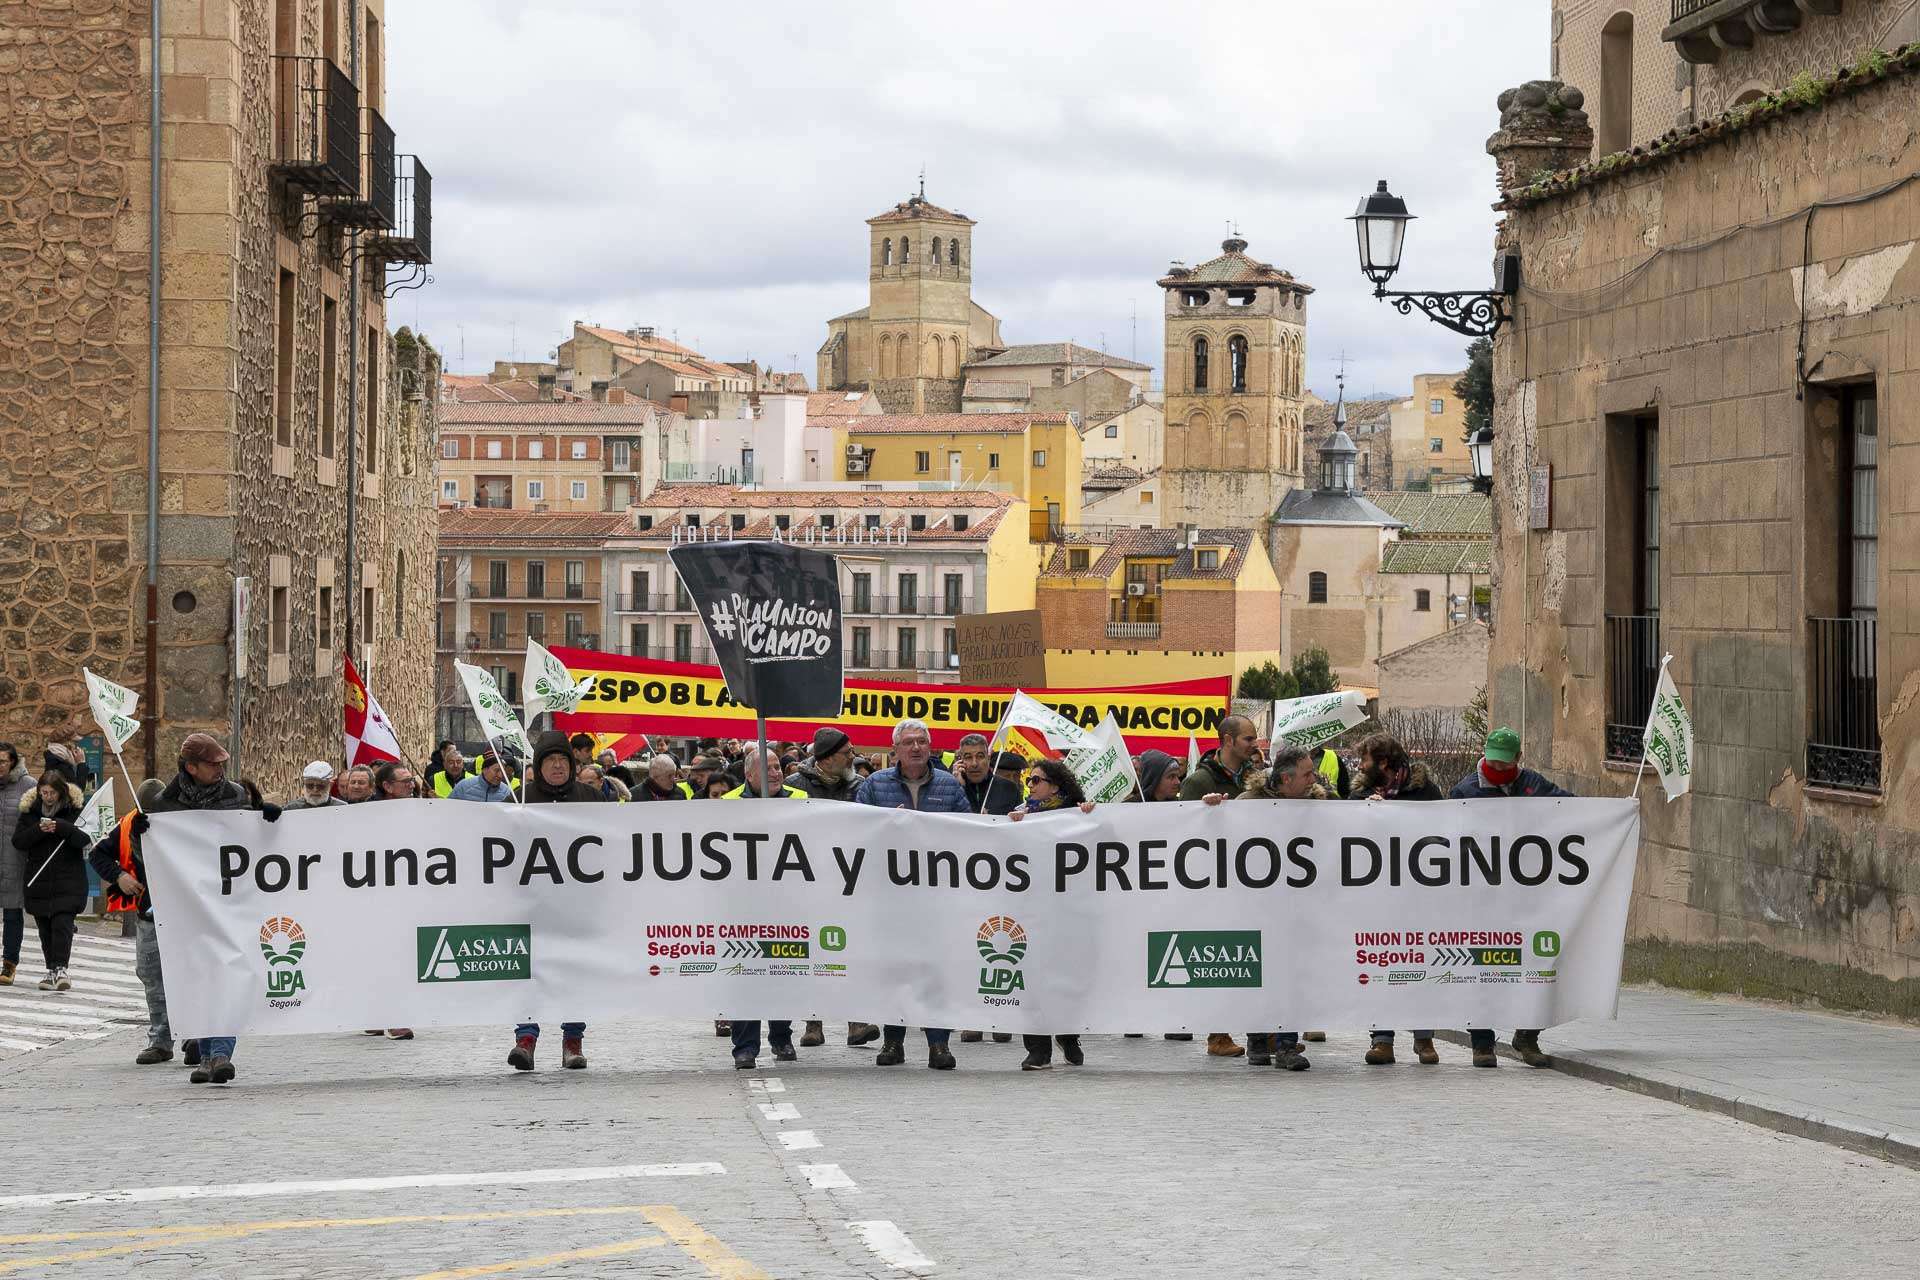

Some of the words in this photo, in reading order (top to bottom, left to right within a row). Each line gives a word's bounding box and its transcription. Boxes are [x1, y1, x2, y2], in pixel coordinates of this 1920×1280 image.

[772, 526, 908, 545] ACUEDUCTO
[841, 692, 951, 722] HUNDE
[1107, 704, 1225, 731] NACION
[1663, 703, 1682, 728] UPA
[220, 844, 321, 895] Por
[343, 847, 456, 889] una
[482, 835, 604, 885] PAC
[623, 832, 815, 882] JUSTA
[833, 847, 865, 897] y
[888, 849, 1031, 893] unos
[1055, 836, 1318, 893] PRECIOS
[1341, 834, 1590, 887] DIGNOS
[647, 925, 692, 938] UNION
[696, 924, 714, 938] DE
[719, 924, 809, 939] CAMPESINOS
[1355, 932, 1401, 946] UNION
[1406, 932, 1424, 946] DE
[1428, 931, 1523, 946] CAMPESINOS
[457, 938, 529, 957] ASAJA
[648, 940, 716, 959] Segovia
[771, 943, 806, 957] UCCL
[1187, 945, 1259, 963] ASAJA
[463, 959, 520, 972] SEGOVIA
[1356, 949, 1425, 967] Segovia
[1482, 951, 1518, 964] UCCL
[977, 968, 1024, 995] UPA
[1193, 967, 1252, 978] SEGOVIA
[266, 970, 305, 997] UPA
[269, 999, 301, 1009] Segovia
[984, 995, 1020, 1007] Segovia
